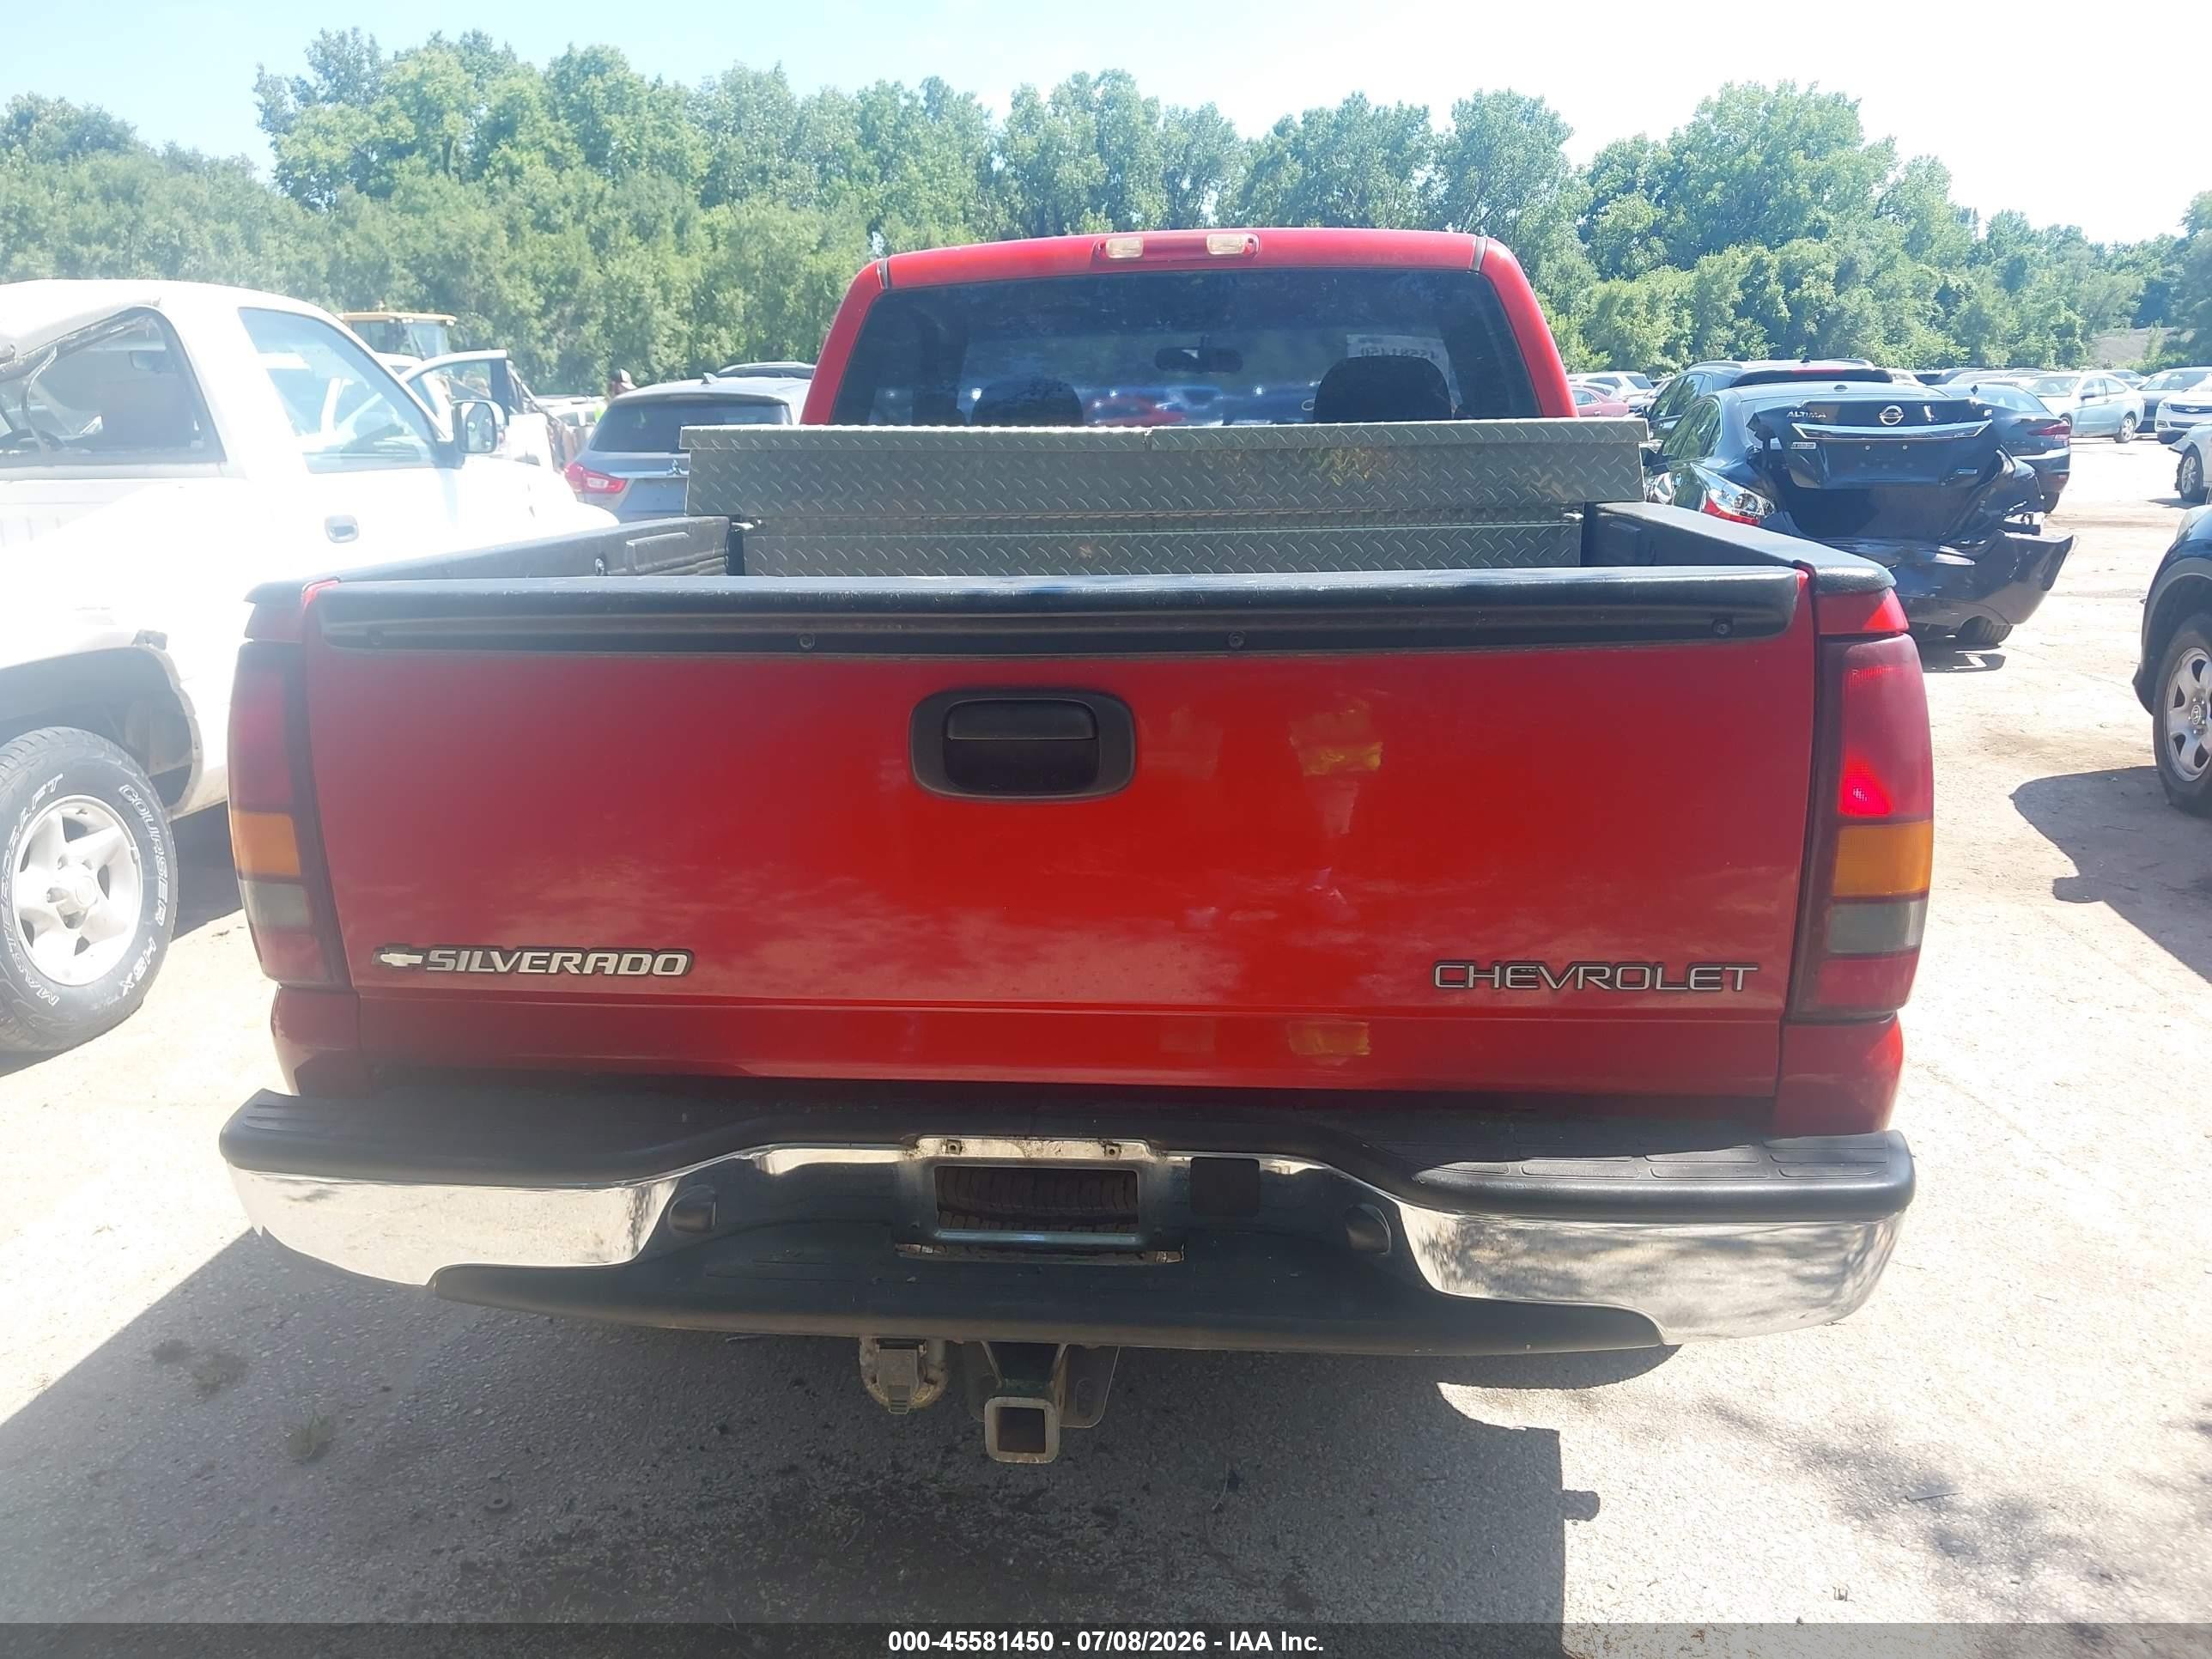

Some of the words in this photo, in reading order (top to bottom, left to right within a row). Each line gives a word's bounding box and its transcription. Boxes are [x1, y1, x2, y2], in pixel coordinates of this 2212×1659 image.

[118, 783, 168, 927] COURSER
[427, 949, 690, 976] SILVERADO
[1433, 963, 1759, 991] CHEVROLET
